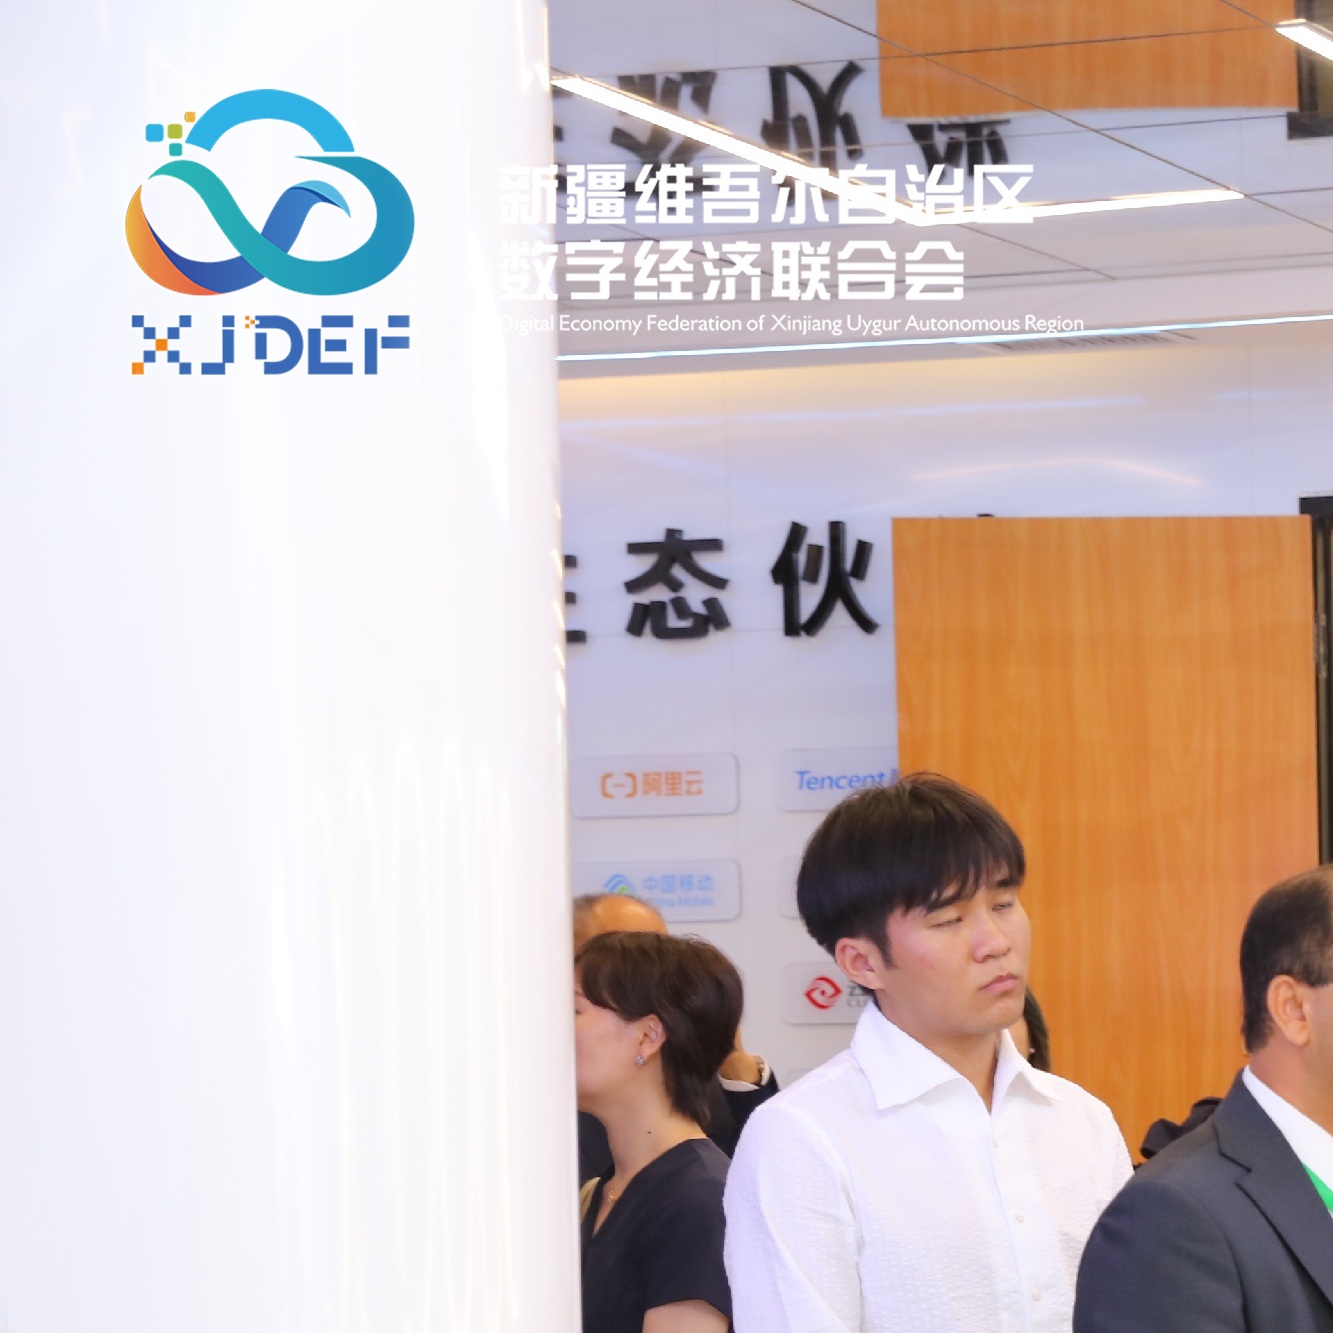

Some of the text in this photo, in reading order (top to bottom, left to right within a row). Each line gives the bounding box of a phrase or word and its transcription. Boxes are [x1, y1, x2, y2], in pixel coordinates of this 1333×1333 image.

[642, 771, 704, 797] 阿里云
[795, 769, 887, 792] Tencent
[642, 873, 715, 894] 中国移动
